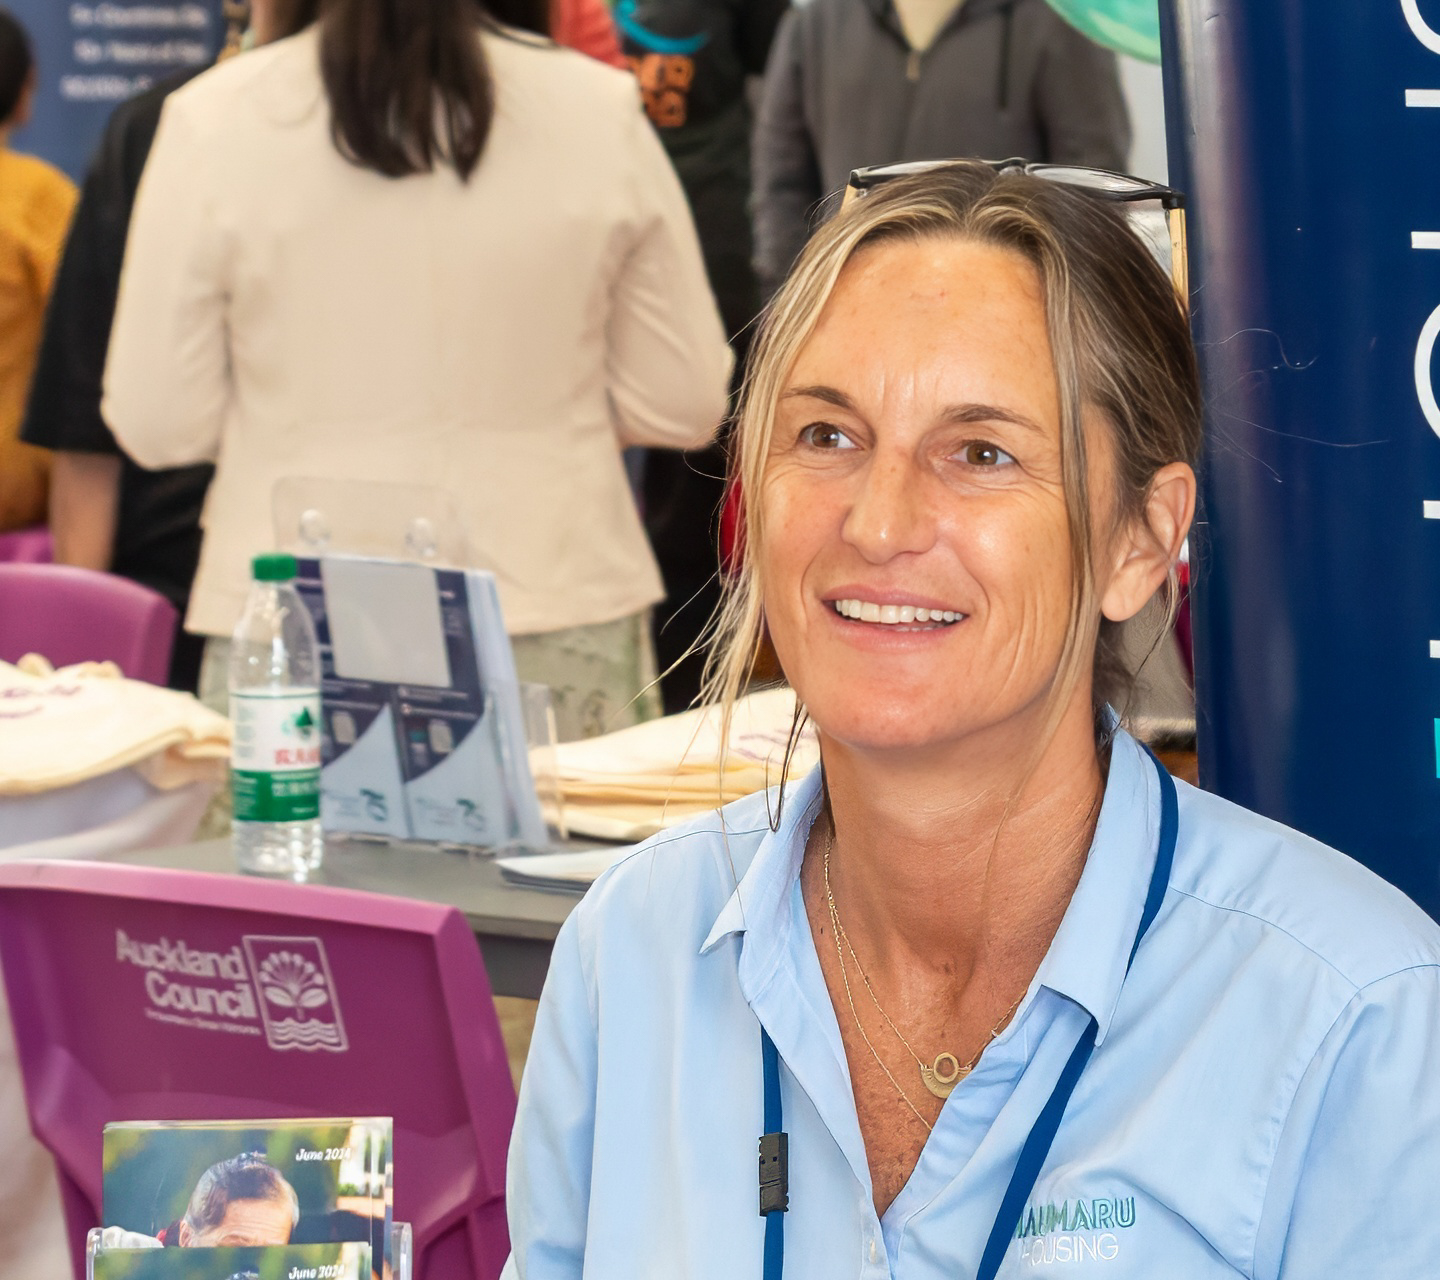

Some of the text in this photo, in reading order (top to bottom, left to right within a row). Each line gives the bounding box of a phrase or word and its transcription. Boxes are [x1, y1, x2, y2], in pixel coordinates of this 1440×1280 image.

[115, 928, 249, 981] Auckland
[145, 970, 258, 1018] Council
[295, 1148, 324, 1161] June
[288, 1266, 317, 1280] June
